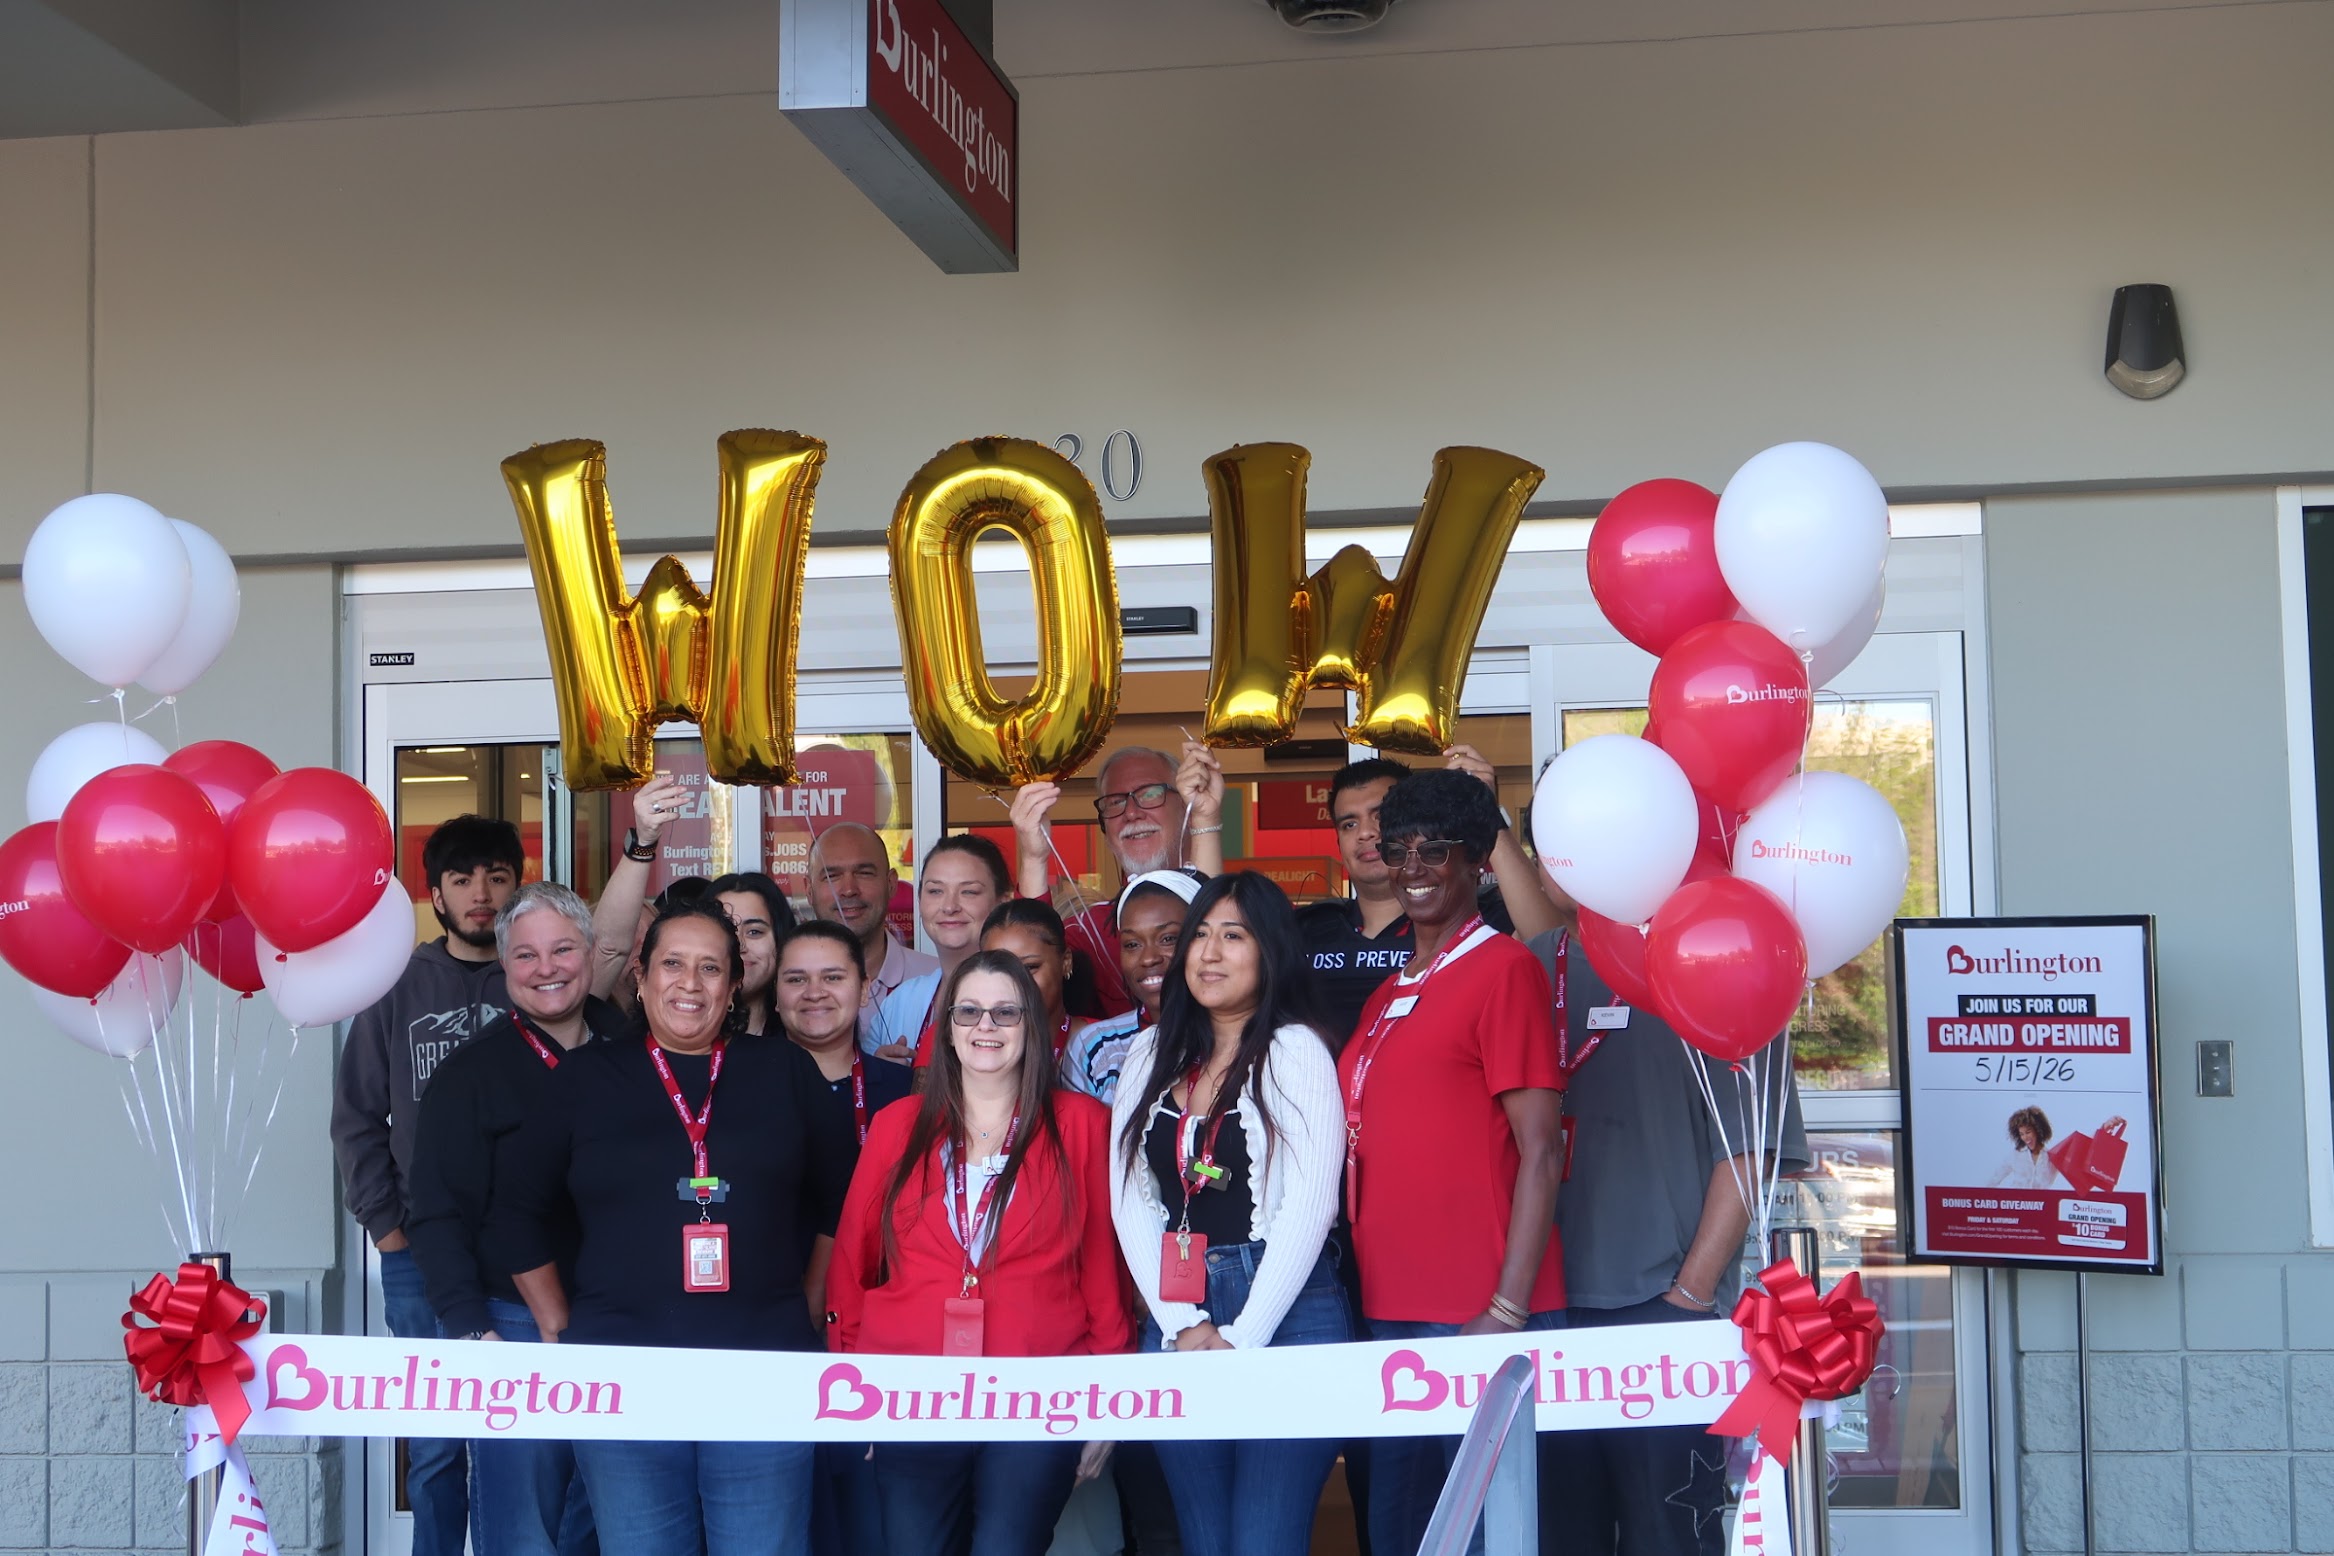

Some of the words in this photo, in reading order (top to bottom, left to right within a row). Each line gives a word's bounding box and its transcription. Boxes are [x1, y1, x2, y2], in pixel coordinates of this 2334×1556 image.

[876, 0, 1010, 203] Burlington
[371, 655, 413, 663] STANLEY
[678, 774, 700, 785] ARE
[806, 771, 827, 782] FOR
[1752, 840, 1852, 866] Burlington
[670, 863, 699, 876] Text
[1947, 944, 2103, 981] Burlington
[1556, 974, 1564, 1009] Burlington
[1966, 999, 1998, 1013] JOIN
[2002, 999, 2022, 1013] US
[2025, 999, 2054, 1013] FOR
[2057, 998, 2088, 1013] OUR
[1559, 1029, 1567, 1068] Burlington
[1939, 1023, 2014, 1046] GRAND
[2021, 1024, 2120, 1047] OPENING
[652, 1047, 669, 1080] Burlington
[1570, 1037, 1599, 1069] Burlington
[1975, 1055, 2075, 1085] 5/15/26
[673, 1093, 691, 1124] Burlington
[1942, 1198, 1972, 1208] BONUS
[1974, 1199, 1998, 1209] CARD
[2000, 1200, 2044, 1211] GIVEAWAY
[2068, 1213, 2089, 1222] GRAND
[2090, 1216, 2116, 1224] OPENING
[2073, 1203, 2112, 1214] Burlington
[265, 1343, 623, 1430] Burlington
[814, 1362, 1187, 1434] Burlington
[1381, 1348, 1752, 1420] Bulington
